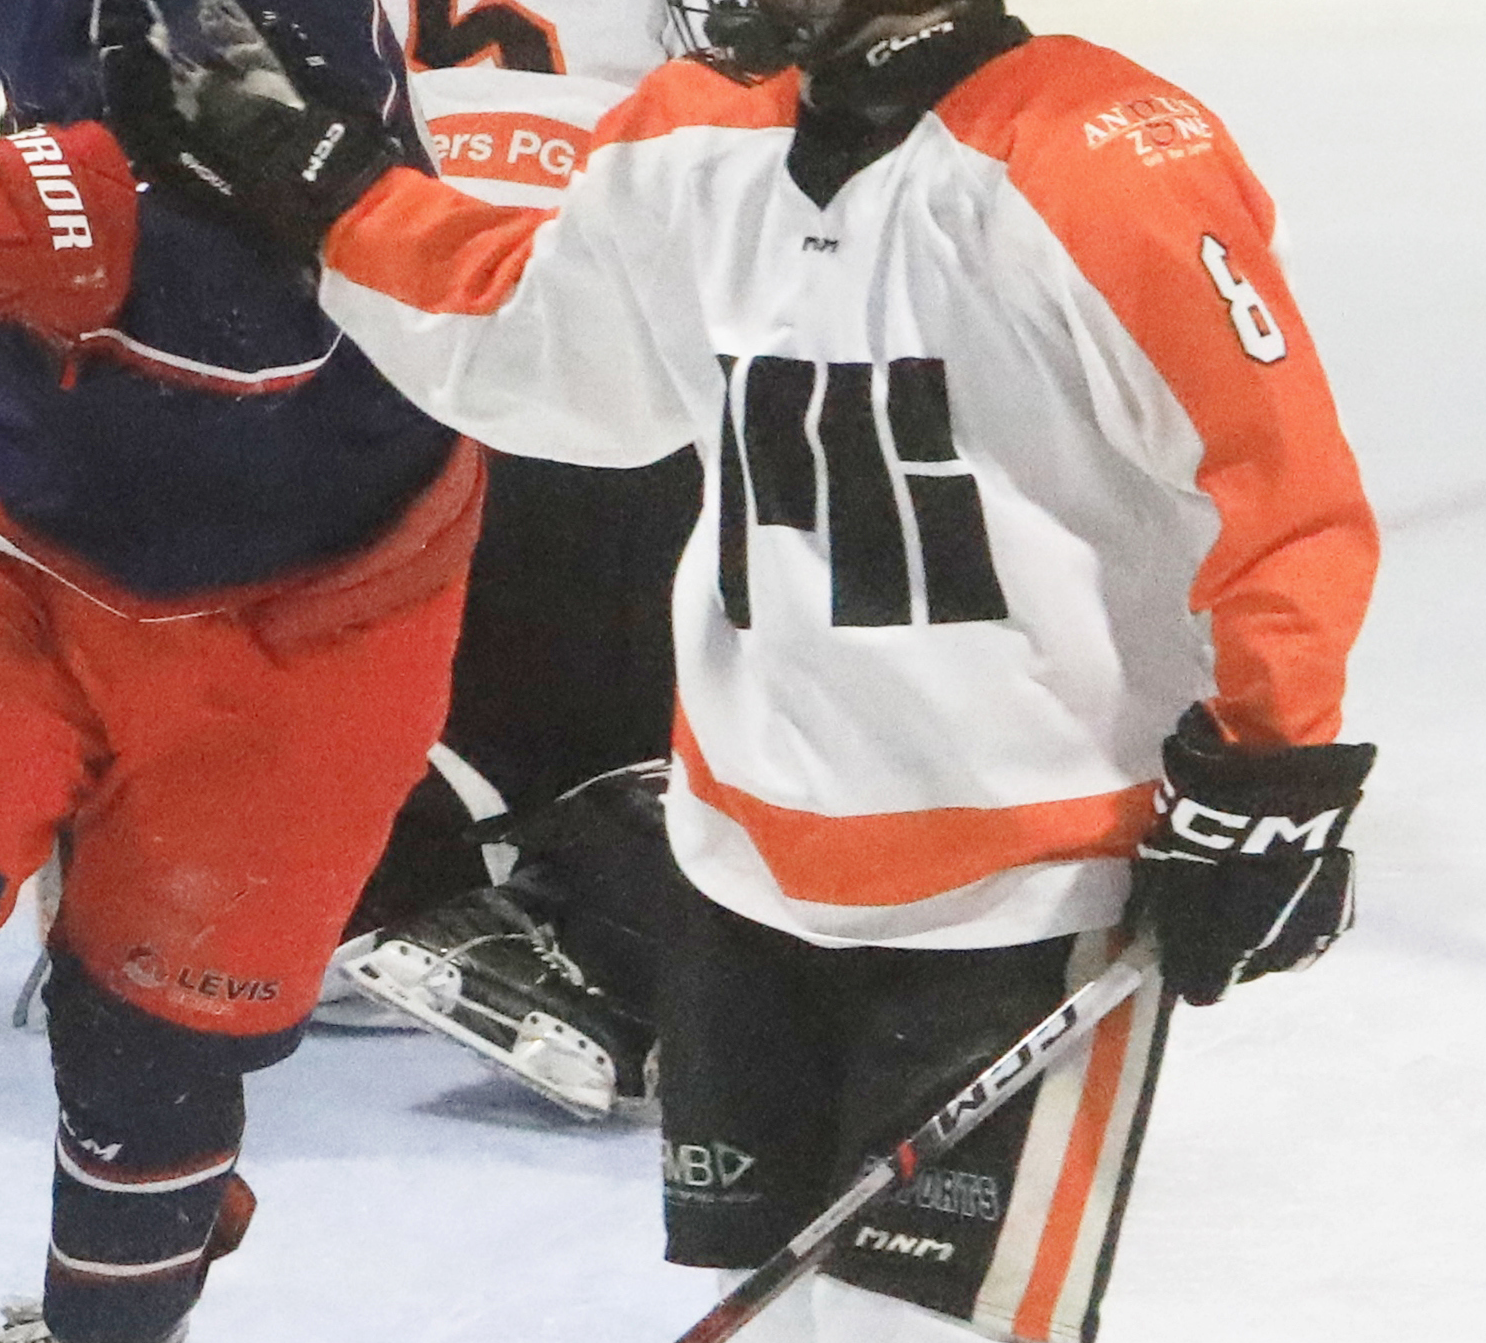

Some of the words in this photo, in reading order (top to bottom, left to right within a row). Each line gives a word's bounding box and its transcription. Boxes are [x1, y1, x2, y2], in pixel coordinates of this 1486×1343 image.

[507, 130, 575, 173] PG
[177, 967, 280, 1002] LEVIS
[855, 1225, 956, 1262] MNM
